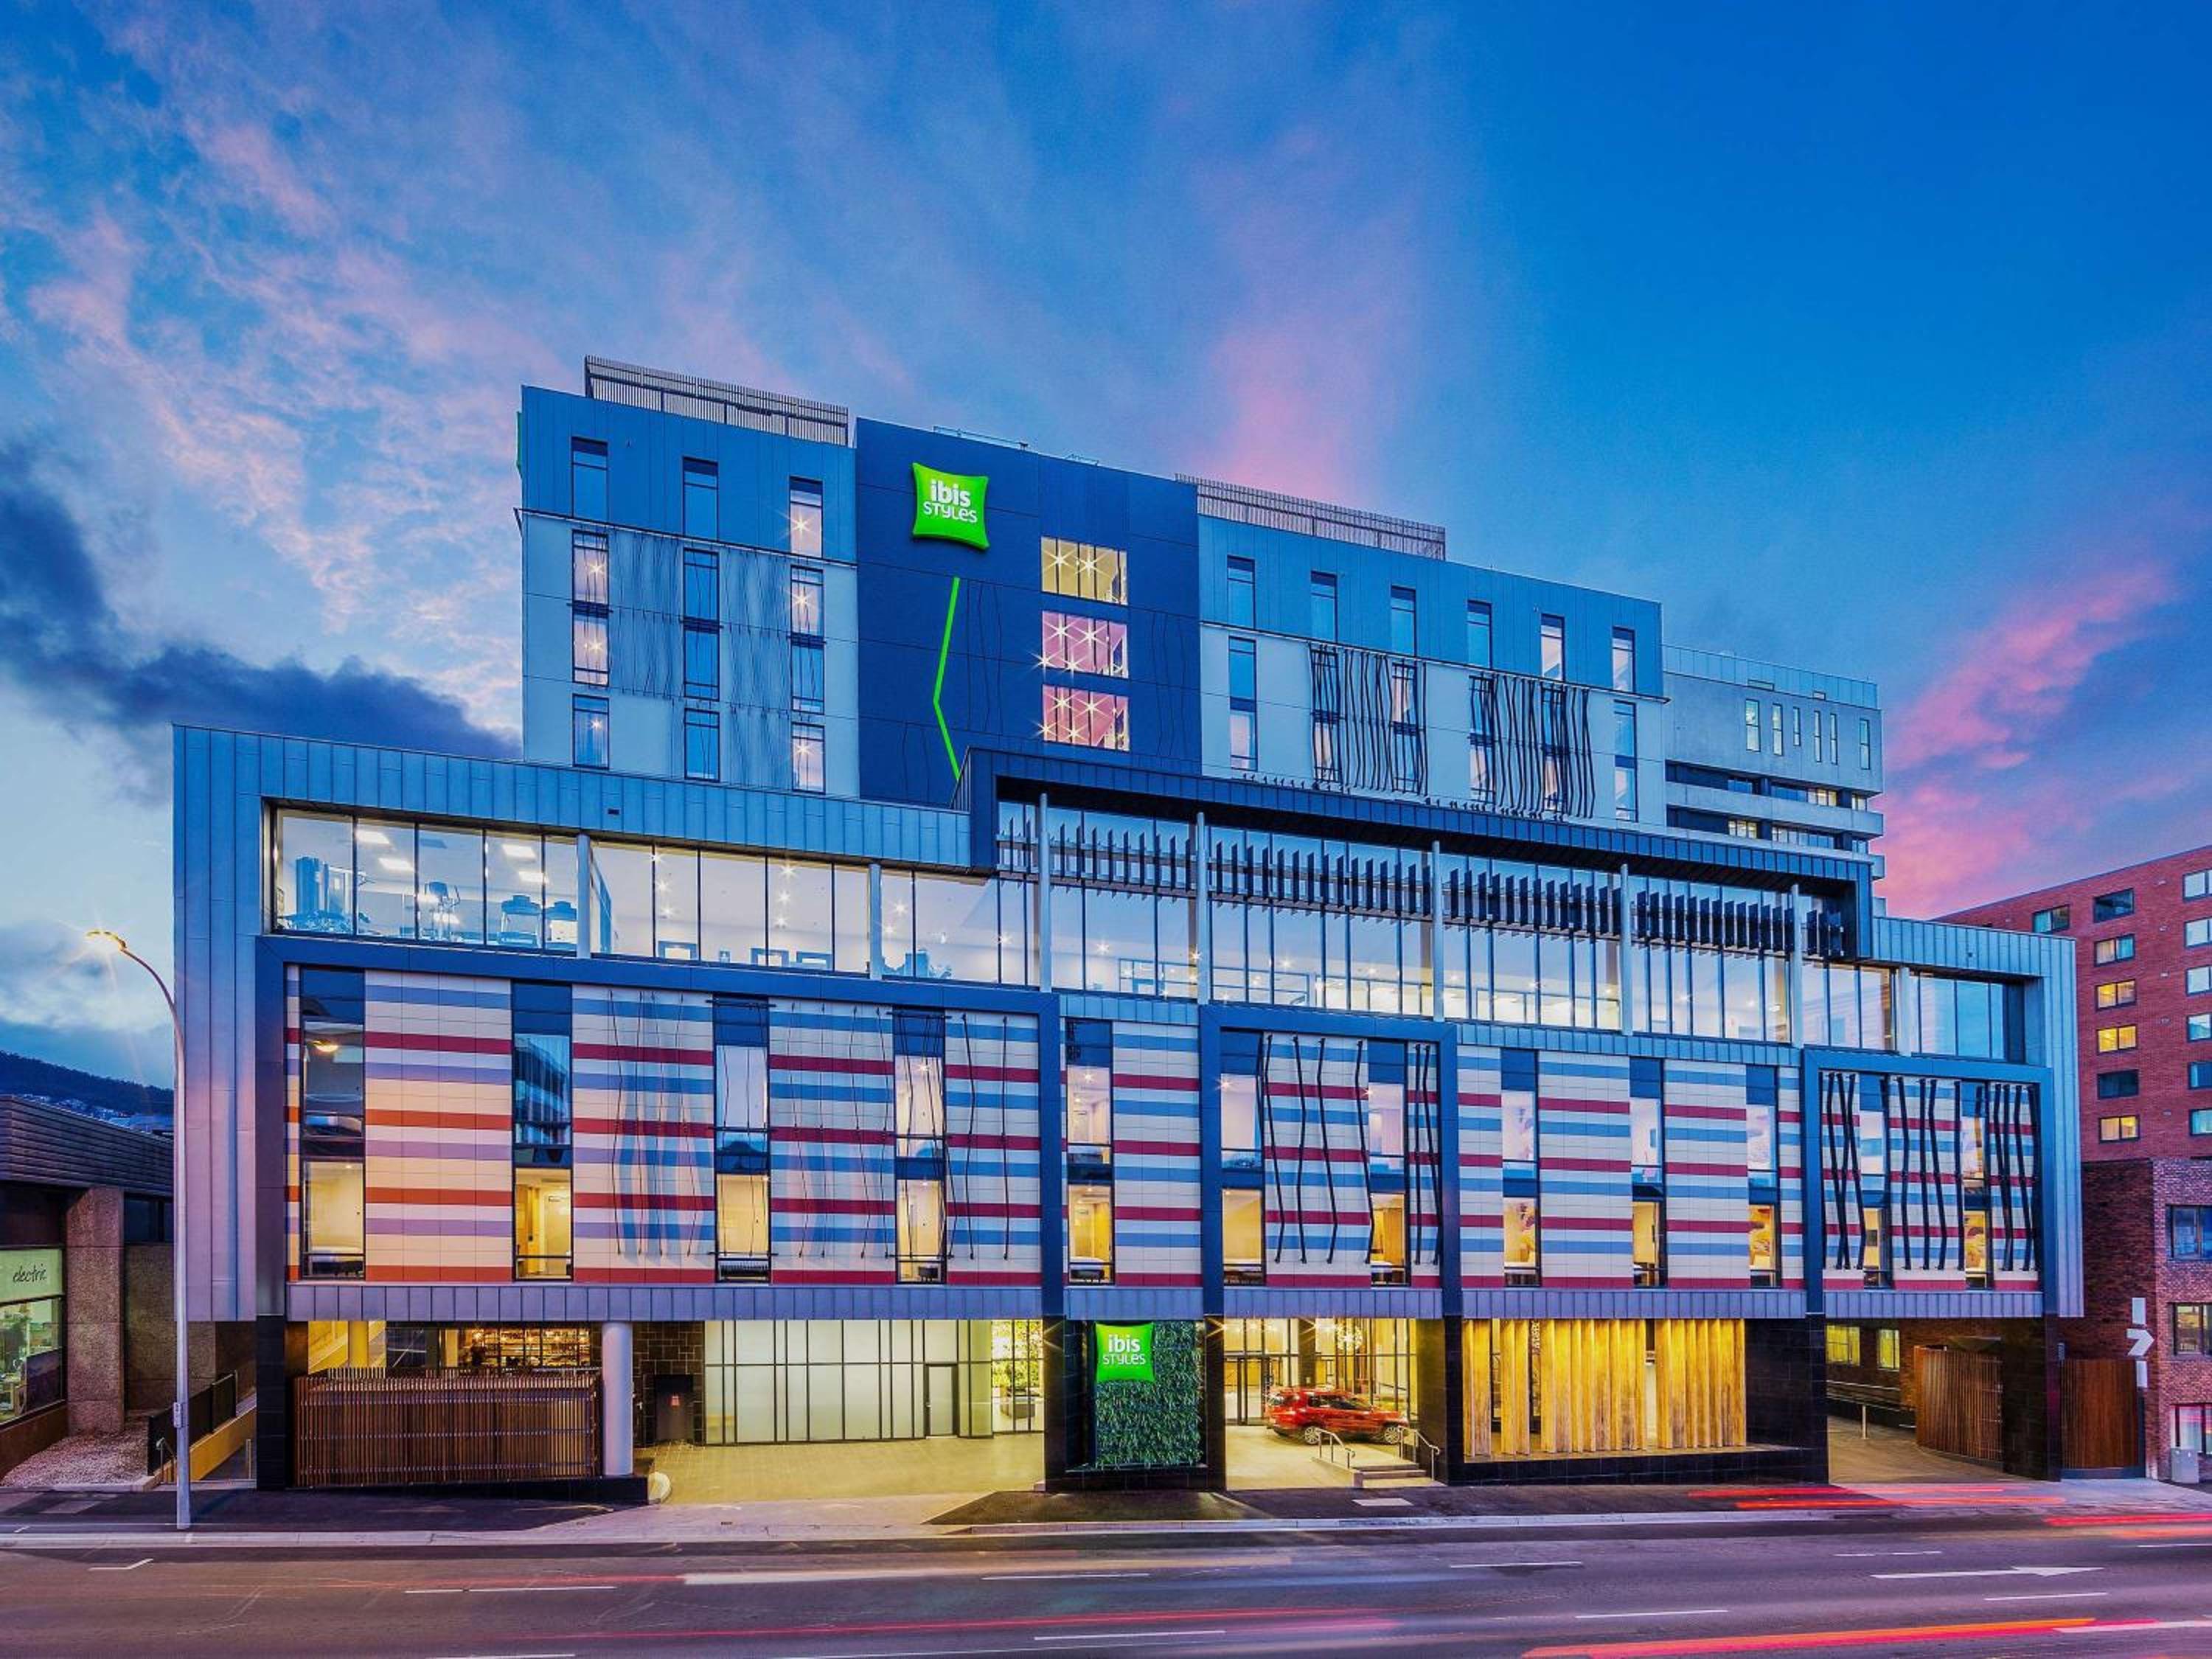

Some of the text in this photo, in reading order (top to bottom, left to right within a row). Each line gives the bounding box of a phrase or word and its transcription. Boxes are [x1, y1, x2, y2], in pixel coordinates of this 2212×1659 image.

[931, 479, 971, 508] ibis
[13, 1263, 46, 1282] electric
[1108, 1334, 1141, 1353] ibis
